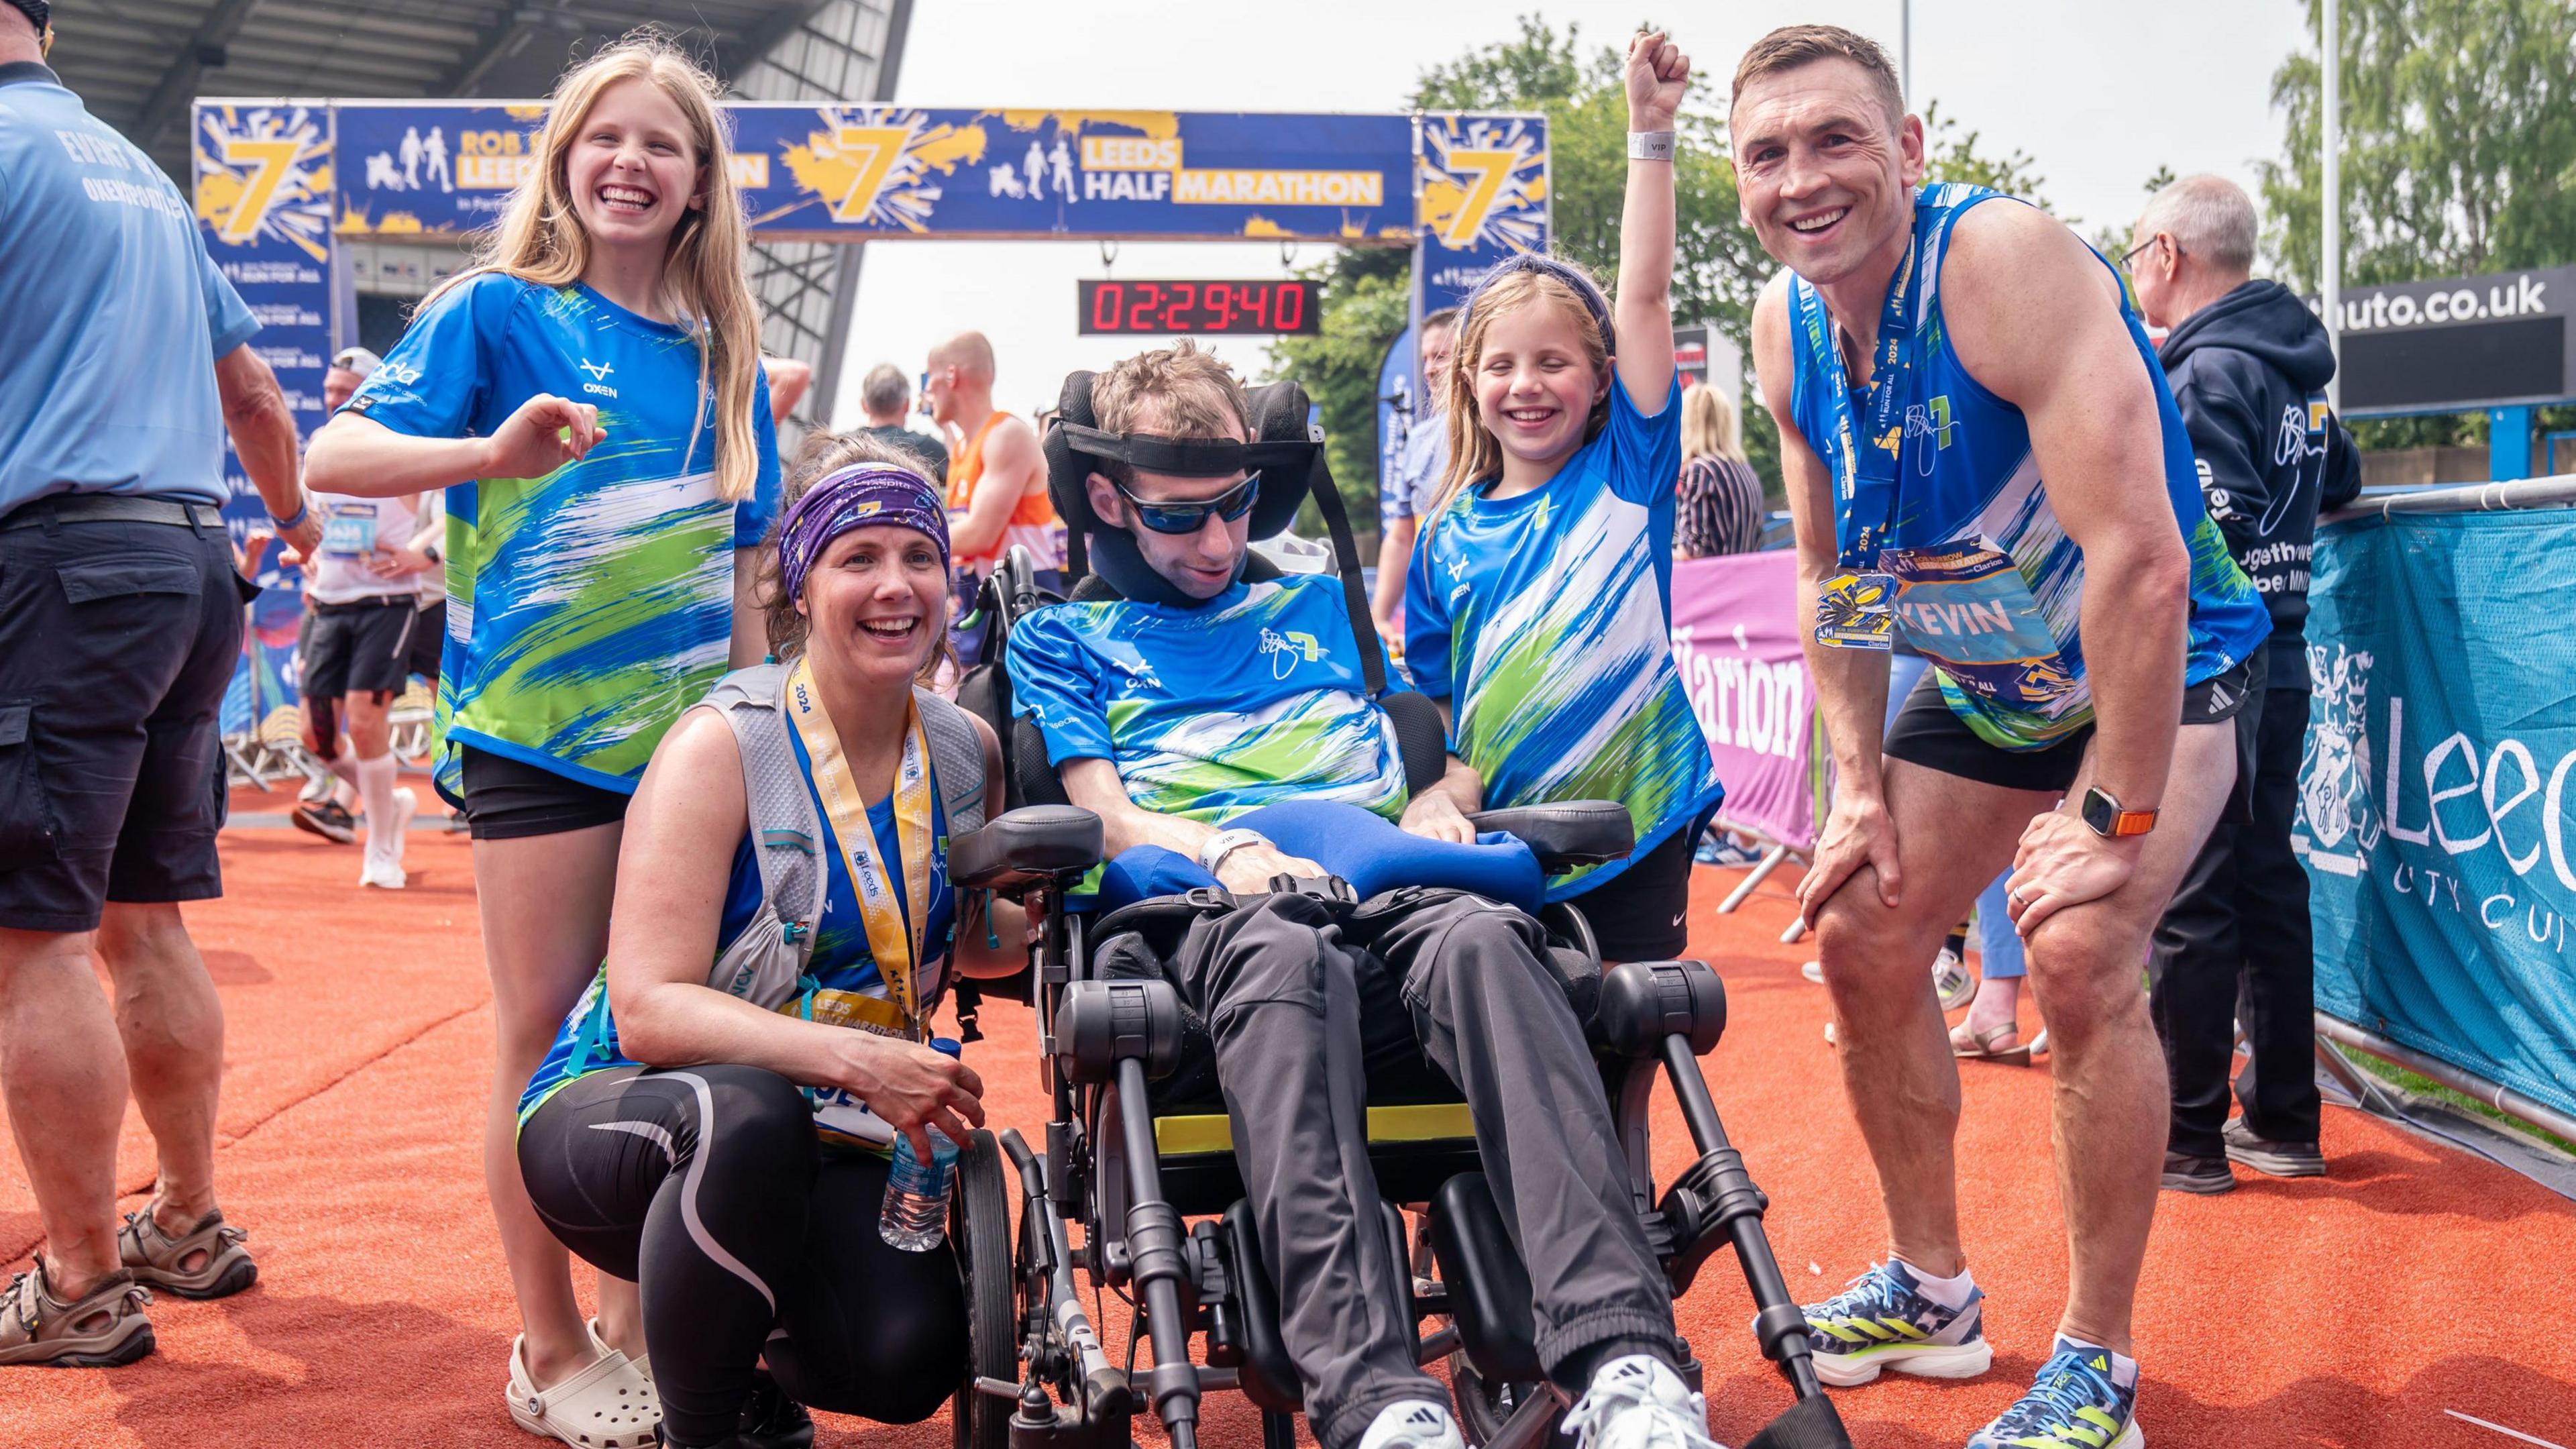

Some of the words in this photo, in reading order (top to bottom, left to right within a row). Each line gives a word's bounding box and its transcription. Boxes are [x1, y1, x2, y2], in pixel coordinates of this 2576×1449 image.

[461, 131, 520, 155] ROB
[1084, 138, 1180, 171] LEEDS
[1652, 143, 1666, 151] VIP
[833, 125, 912, 223] 7
[1084, 172, 1171, 202] HALF
[1177, 172, 1378, 203] MARATHON
[221, 140, 302, 240] 7
[1445, 148, 1519, 246] 7
[1092, 282, 1305, 331] 02:29:40
[1887, 337, 1898, 365] 2024
[583, 383, 618, 399] OXEN
[1885, 384, 1893, 398] FOR
[1887, 373, 1895, 384] ALL
[1858, 525, 1871, 552] 2024
[1973, 558, 2004, 573] Clarion
[1895, 598, 2015, 636] KEVIN
[795, 683, 812, 714] 2024
[1978, 681, 1997, 692] ALL
[906, 737, 914, 767] Leeds
[826, 775, 848, 822] MARATHON
[916, 810, 924, 861] MARATHON
[1220, 835, 1235, 845] VIP
[861, 865, 879, 897] Leeds
[816, 998, 852, 1016] LEEDS
[816, 1012, 842, 1026] HALF
[845, 1018, 906, 1039] MARATHON
